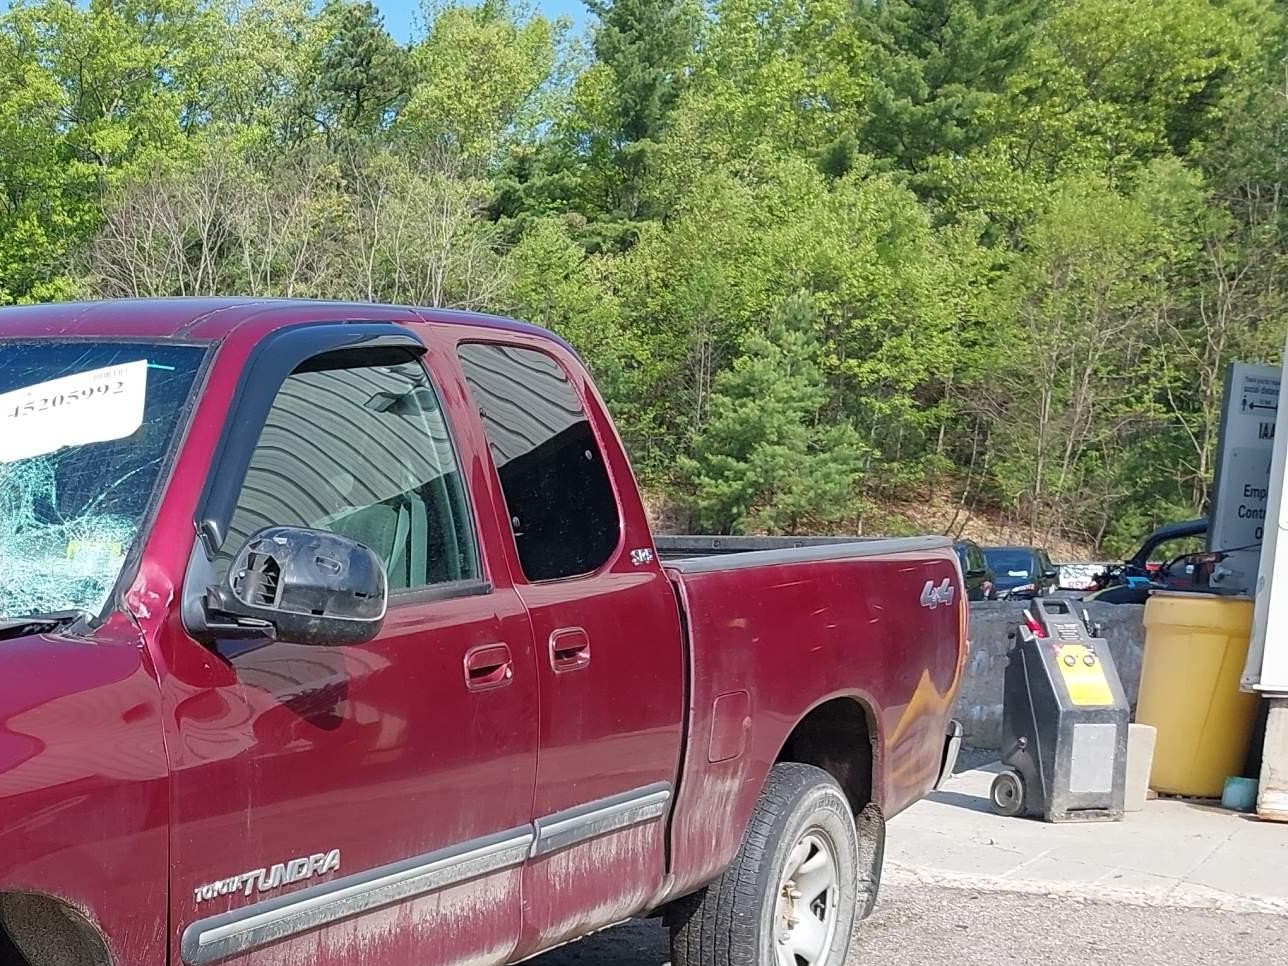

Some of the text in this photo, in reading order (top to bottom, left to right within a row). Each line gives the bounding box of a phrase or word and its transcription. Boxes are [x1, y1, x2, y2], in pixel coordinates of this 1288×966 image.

[8, 381, 124, 418] 45205992
[194, 848, 341, 903] TOYOTA TUNDRA
